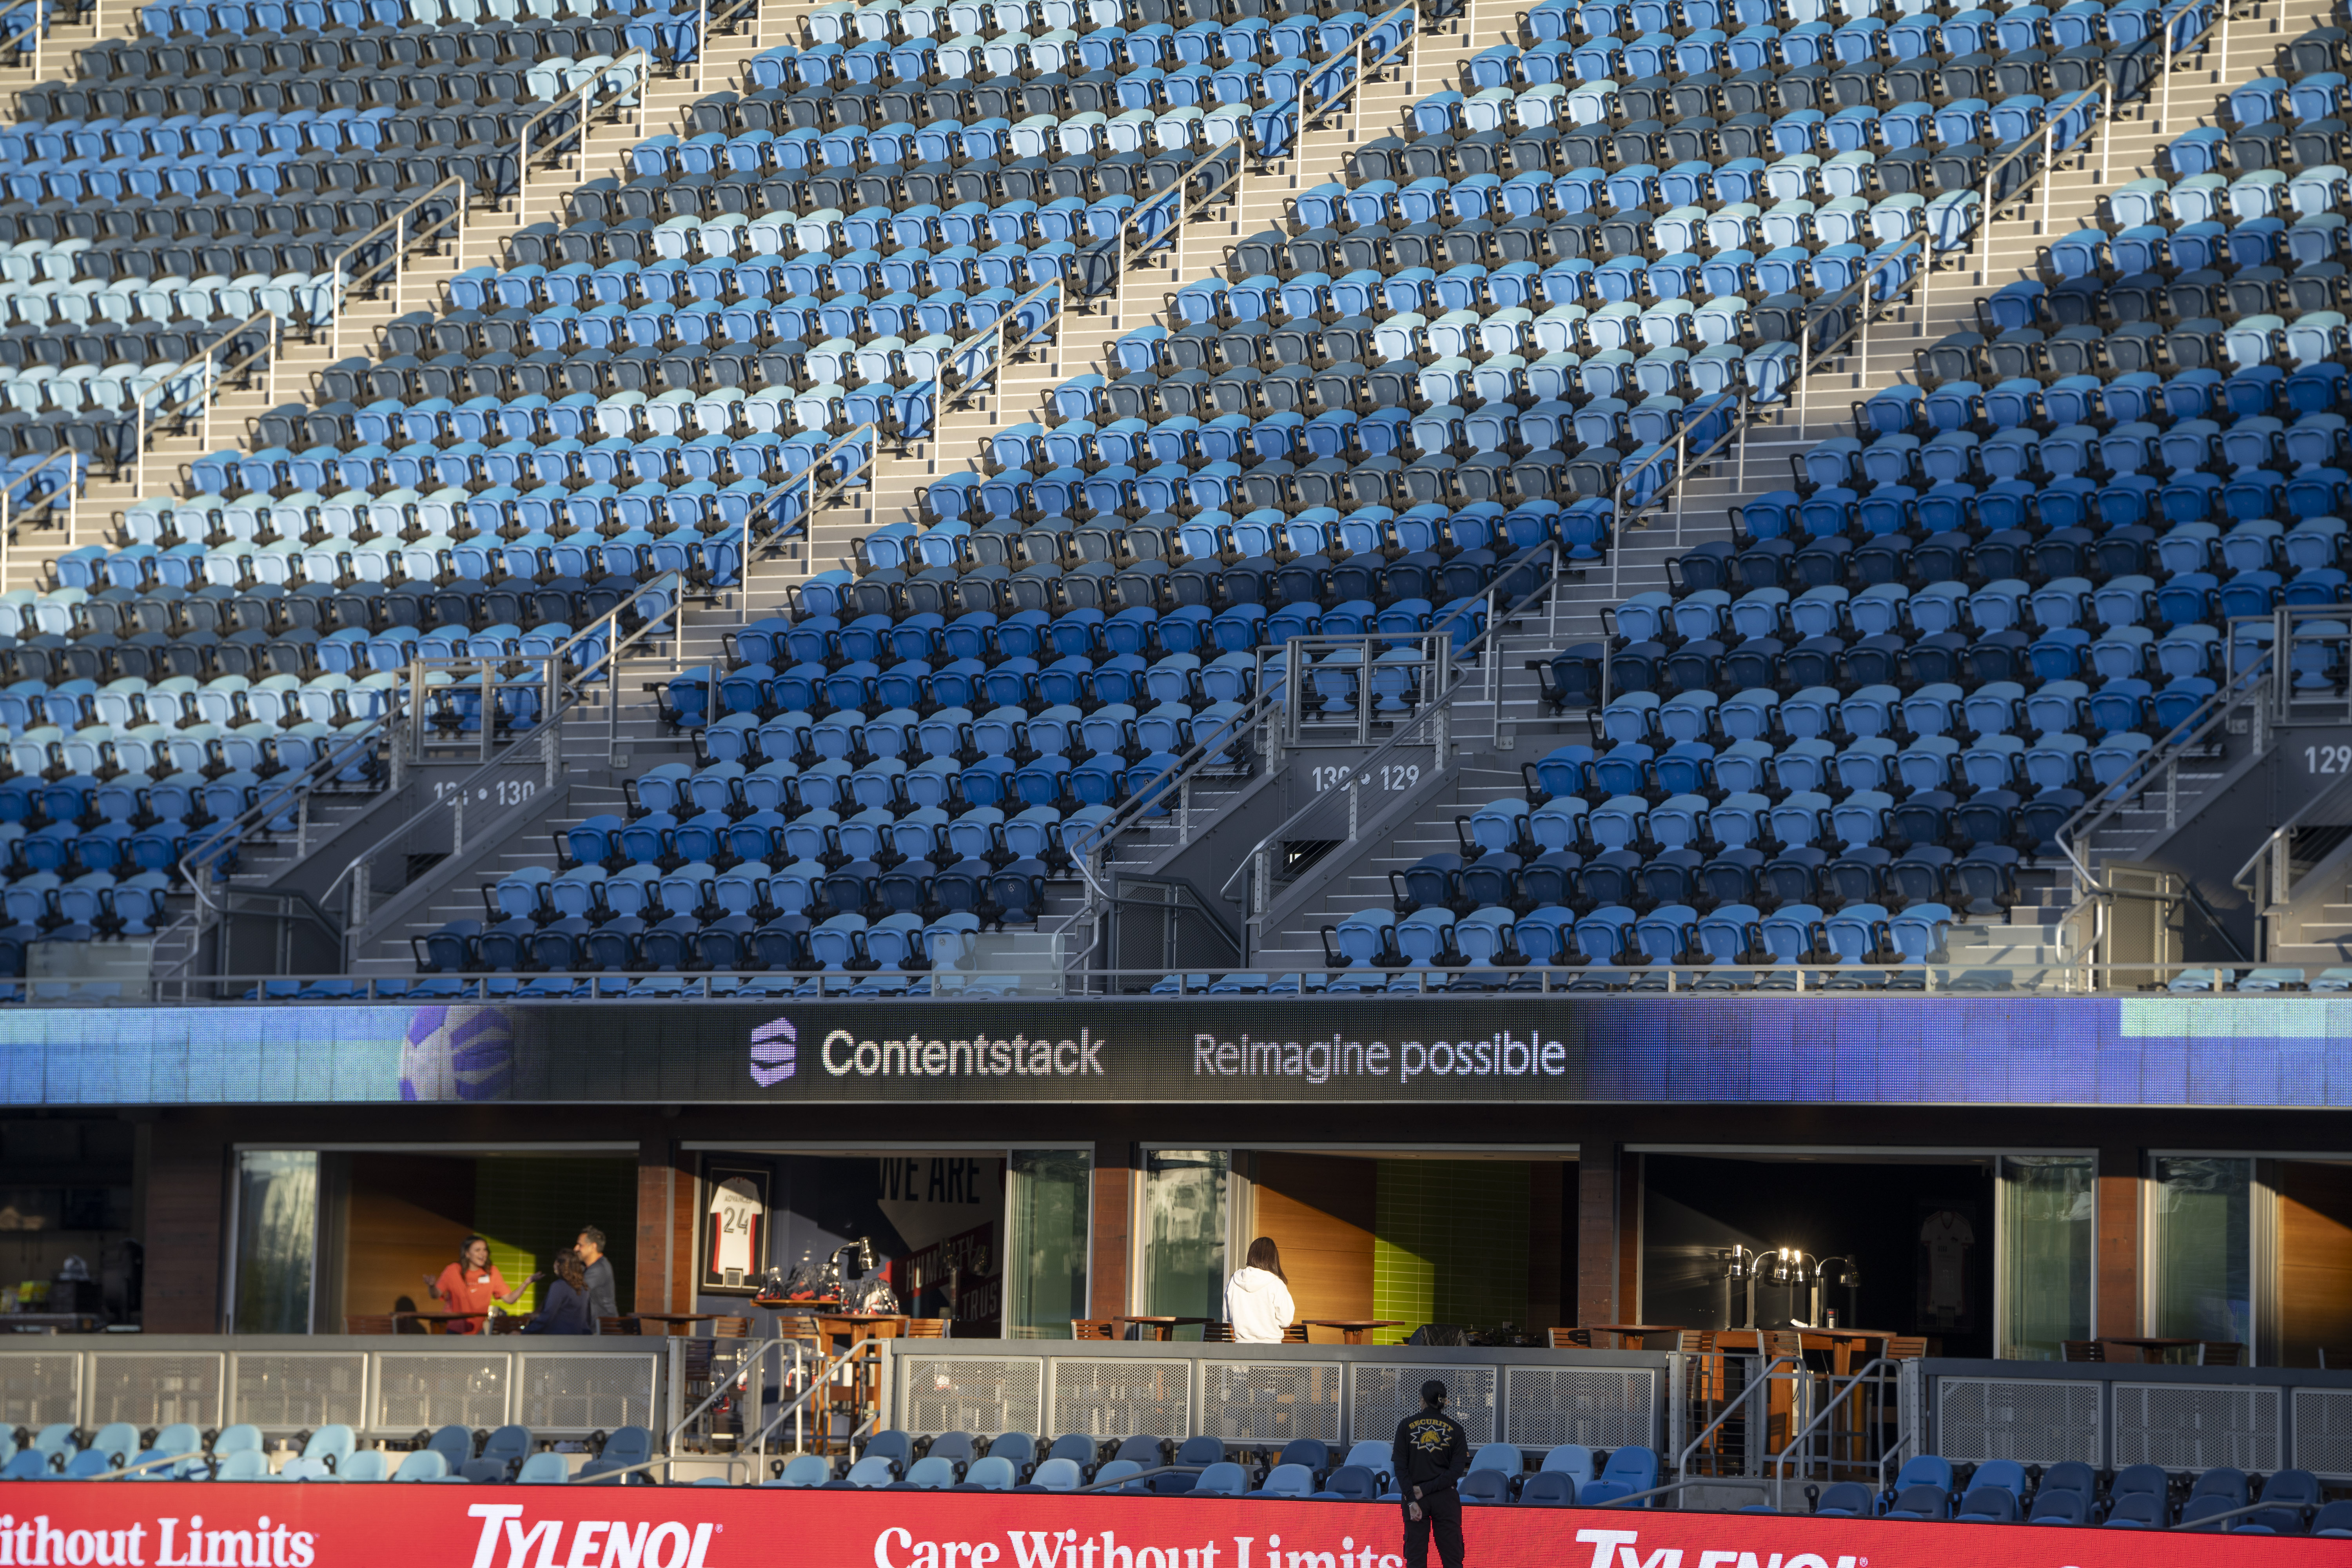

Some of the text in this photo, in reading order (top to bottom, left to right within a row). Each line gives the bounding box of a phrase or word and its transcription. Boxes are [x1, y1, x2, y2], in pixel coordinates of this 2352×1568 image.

[1312, 764, 1419, 792] 130 129
[2305, 745, 2352, 773] 129
[496, 780, 535, 806] 130
[821, 1027, 1105, 1076] Contentstack
[1193, 1030, 1566, 1084] Reimagine possible
[928, 1158, 980, 1204] ARE
[723, 1206, 748, 1235] 24
[962, 1278, 1002, 1321] TRUS
[1409, 1419, 1454, 1432] SECURITY
[0, 1514, 315, 1568] ithout Limits
[874, 1527, 1000, 1568] Care
[1007, 1528, 1221, 1568] Without
